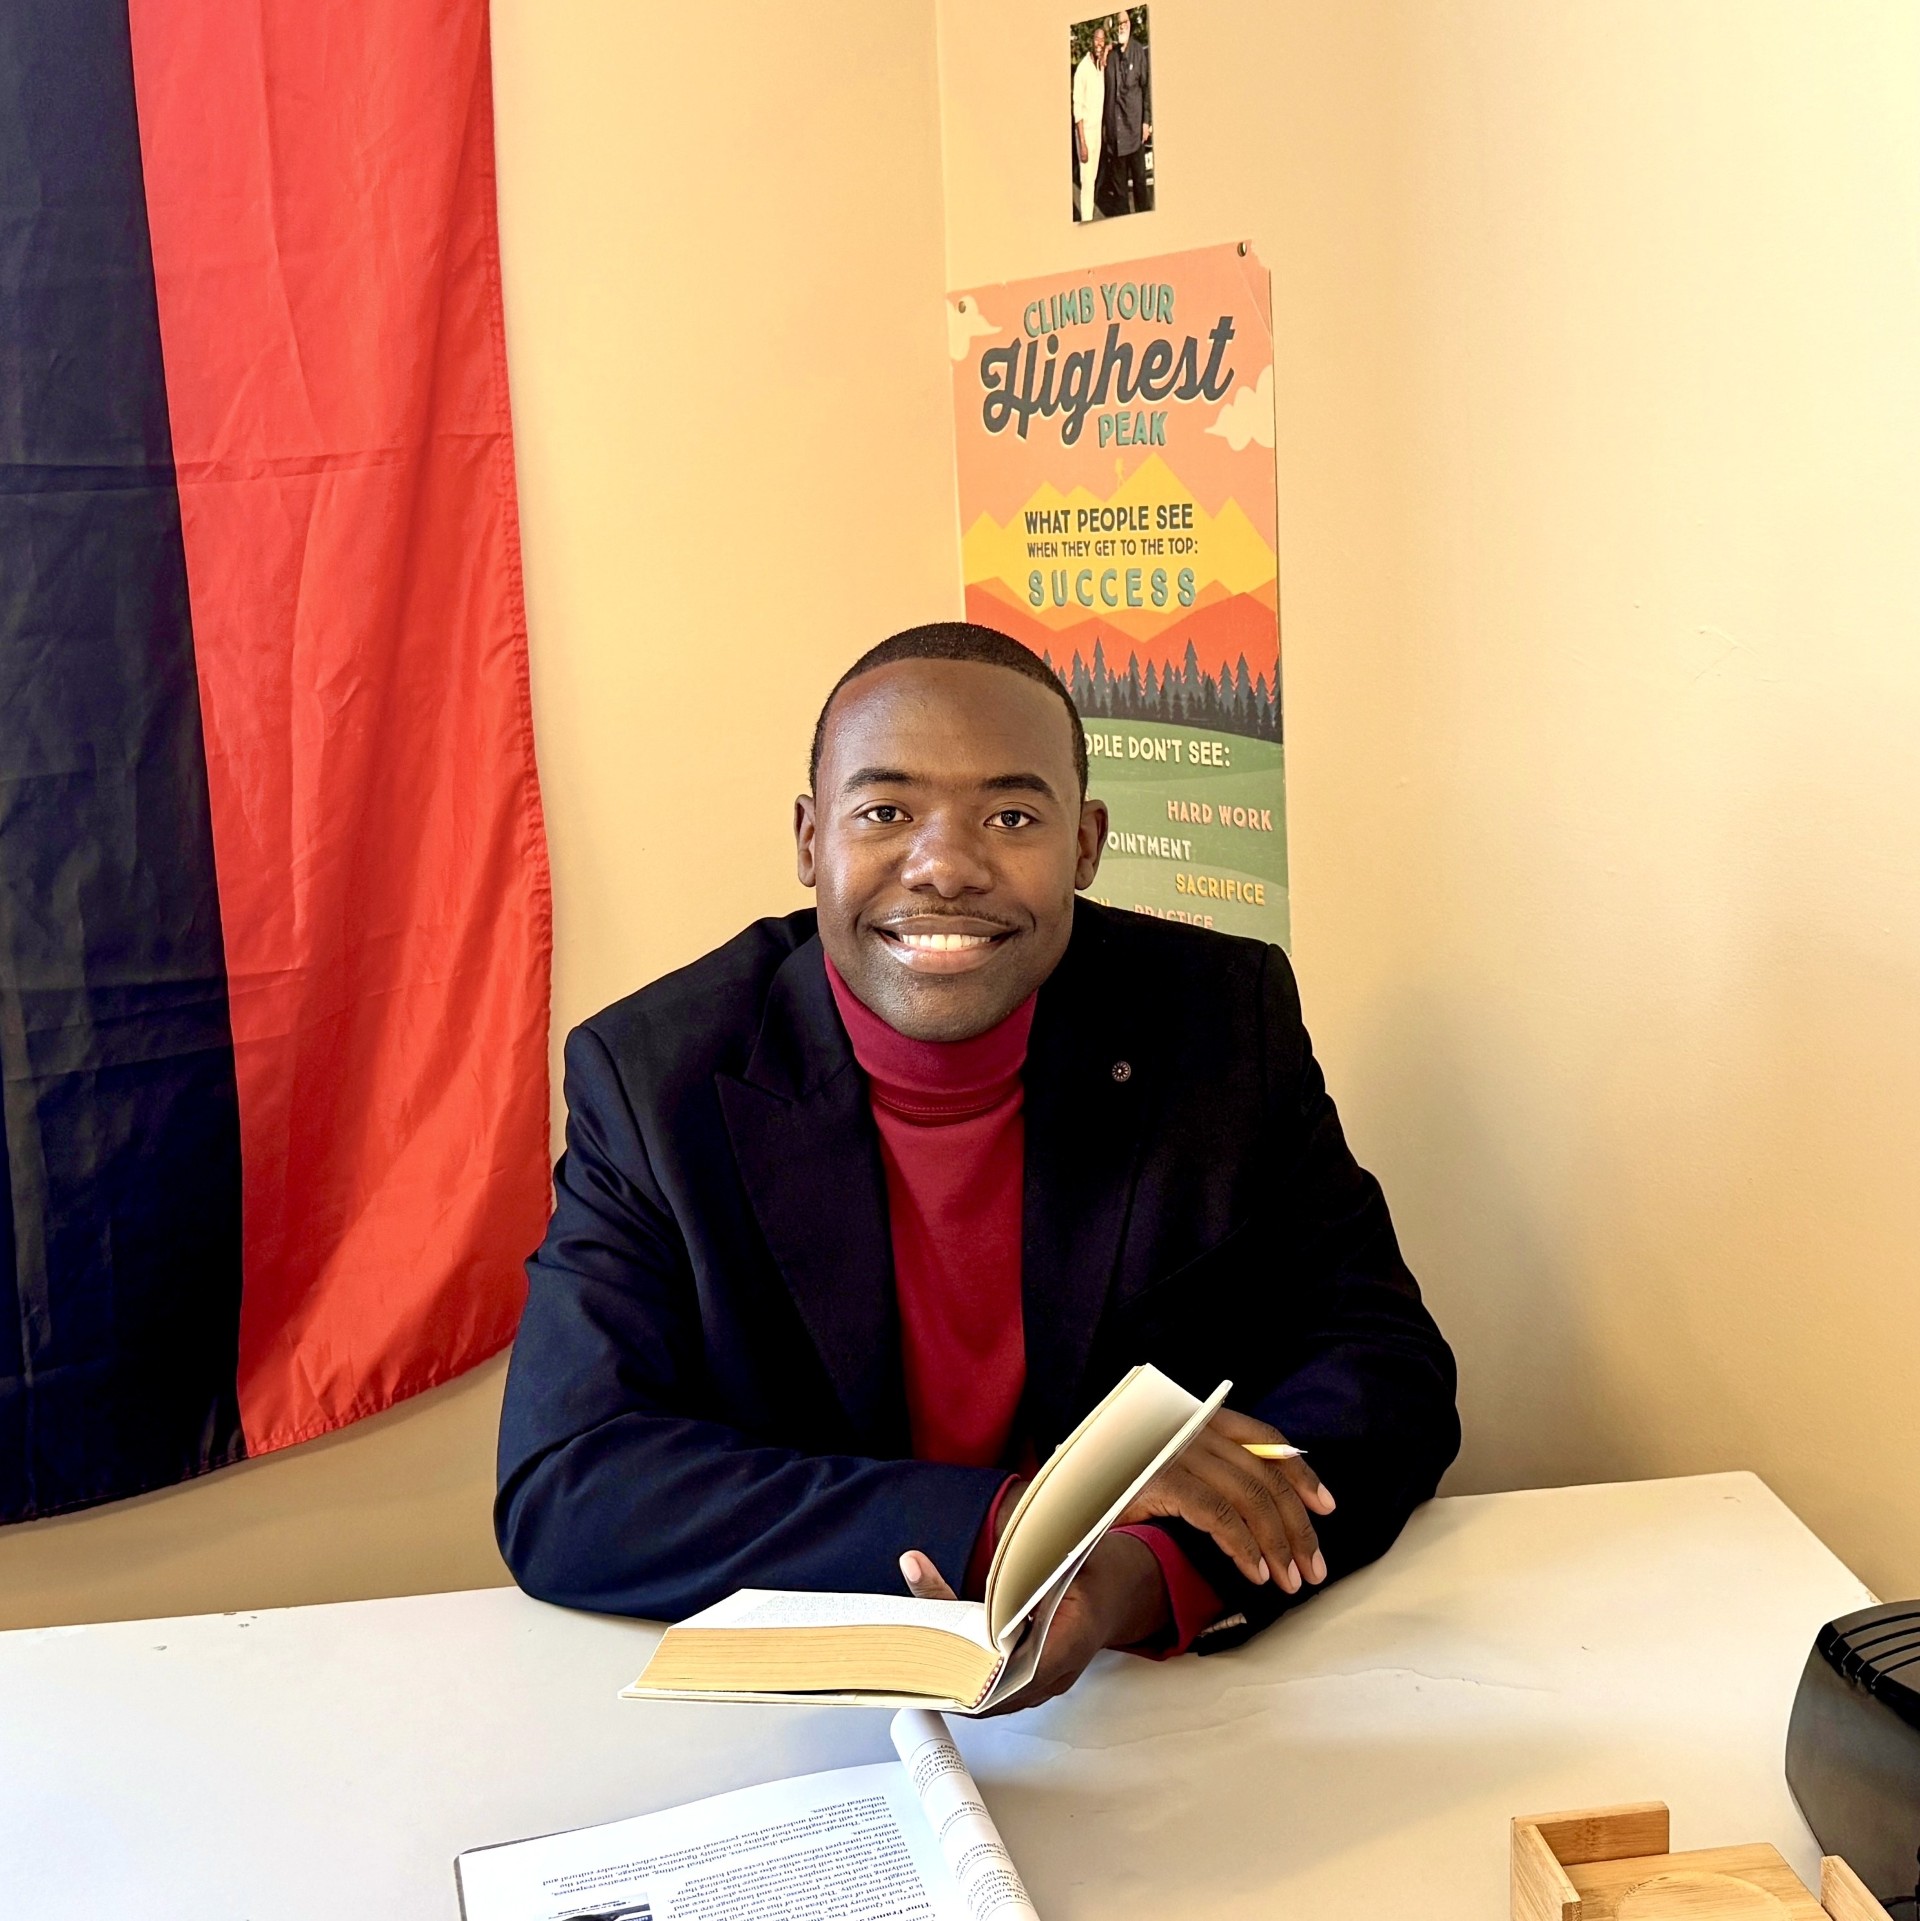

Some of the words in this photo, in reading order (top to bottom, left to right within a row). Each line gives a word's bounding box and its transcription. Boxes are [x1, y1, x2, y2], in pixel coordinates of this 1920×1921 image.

[1024, 286, 1095, 337] CLIMB
[1100, 282, 1174, 324] YOUR
[980, 316, 1235, 445] Highest
[1098, 411, 1168, 448] PEAK
[1025, 510, 1070, 534] WHAT
[1078, 506, 1149, 532] PEOPLE
[1156, 503, 1193, 529] SEE
[1027, 542, 1058, 558] WHEN
[1061, 540, 1091, 558] THEY
[1095, 540, 1117, 556] GET
[1120, 539, 1135, 556] TO
[1140, 538, 1164, 555] THE
[1168, 537, 1198, 555] TOP:
[1028, 568, 1196, 607] SUCCESS
[1084, 733, 1124, 758] OPLE
[1128, 737, 1182, 763] DON'T
[1188, 741, 1231, 767] SEE:
[1167, 800, 1213, 825] HARD
[1218, 805, 1273, 831] WORK
[1107, 831, 1192, 861] OINTMENT
[1175, 873, 1266, 906] SACRIFICE
[846, 1795, 885, 1807] historical
[853, 1801, 887, 1812] author's
[838, 1814, 854, 1823] will
[854, 1807, 890, 1818] students
[861, 1813, 892, 1823] Focus:
[759, 1818, 807, 1835] understand
[792, 1818, 837, 1833] strengthen
[824, 1820, 861, 1833] Through
[772, 1829, 792, 1838] their
[779, 1829, 823, 1844] structured
[873, 1828, 899, 1838] ability
[703, 1835, 739, 1850] personal
[743, 1835, 770, 1845] ability
[824, 1837, 862, 1851] interpret
[700, 1845, 732, 1857] identify
[844, 1839, 885, 1854] rhetorical
[659, 1846, 702, 1860] narratives
[766, 1847, 824, 1866] informational
[803, 1849, 843, 1863] strategies
[834, 1849, 873, 1862] Students
[878, 1848, 908, 1859] engage
[631, 1857, 658, 1867] reflect
[657, 1854, 698, 1867] figurative
[743, 1861, 765, 1870] texts
[778, 1860, 801, 1869] while
[818, 1859, 834, 1868] will
[845, 1855, 877, 1867] readers
[596, 1863, 630, 1874] broader
[759, 1865, 777, 1874] also
[794, 1863, 817, 1872] learn
[798, 1866, 834, 1879] complex
[873, 1862, 914, 1876] analyzing
[560, 1870, 594, 1883] cultural
[575, 1873, 614, 1886] interpret
[685, 1872, 725, 1887] historical
[699, 1871, 758, 1890] strengthening
[742, 1872, 782, 1886] recognize
[815, 1875, 832, 1883] text
[882, 1869, 917, 1881] struggle
[598, 1876, 632, 1887] creative
[738, 1875, 797, 1894] conversations
[774, 1879, 813, 1893] structure
[823, 1876, 857, 1890] authors'
[865, 1876, 920, 1895] development
[677, 1886, 698, 1896] their
[712, 1891, 737, 1902] about
[888, 1888, 908, 1897] "not
[691, 1898, 710, 1906] race
[715, 1894, 755, 1908] language
[795, 1893, 818, 1903] focus
[805, 1899, 828, 1909] ideas
[829, 1893, 853, 1904] racist
[850, 1894, 881, 1906] history
[747, 1906, 765, 1915] unit
[766, 1902, 783, 1910] this
[823, 1902, 849, 1914] book"
[849, 1901, 884, 1914] Quarter
[905, 1901, 932, 1912] Time
[677, 1908, 699, 1919] used
[698, 1906, 739, 1921] historical
[728, 1912, 745, 1921] will
[756, 1908, 792, 1920] America
[790, 1909, 822, 1920] history
